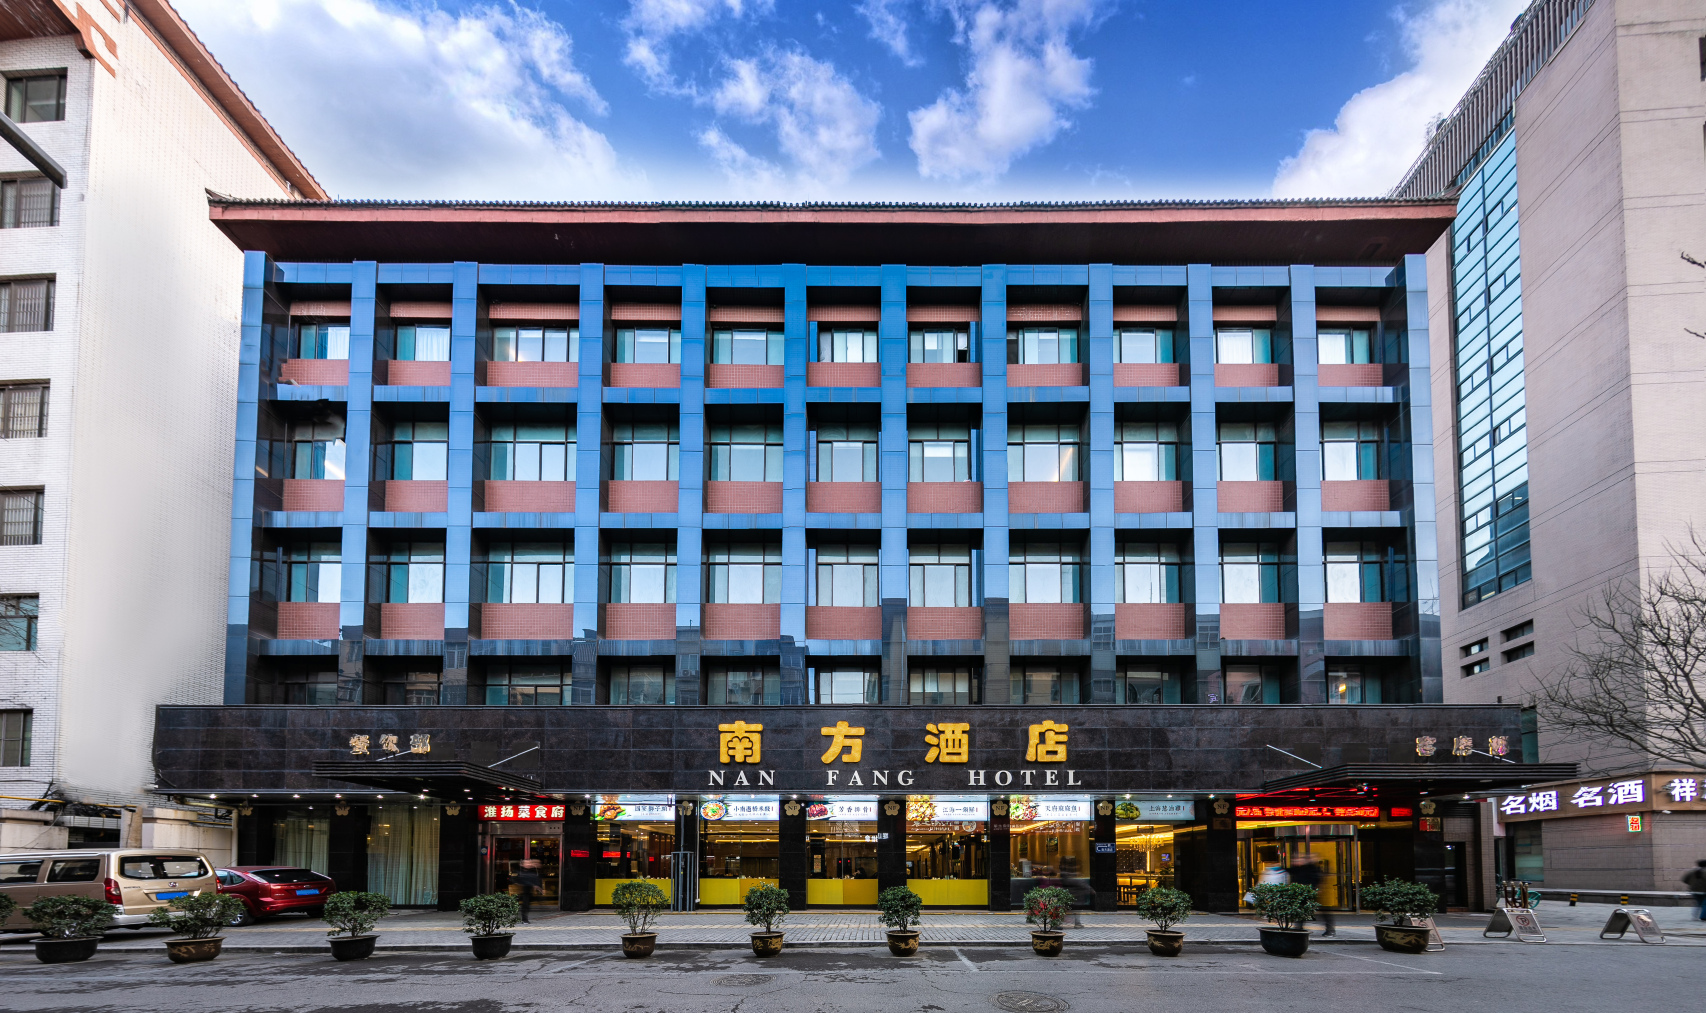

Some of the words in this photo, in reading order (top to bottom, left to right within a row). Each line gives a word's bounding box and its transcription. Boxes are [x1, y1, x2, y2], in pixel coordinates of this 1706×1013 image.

[718, 720, 1069, 764] 南方酒店
[708, 770, 776, 786] NAN
[826, 770, 915, 786] FANG
[968, 770, 1082, 786] HOTEL
[1500, 790, 1559, 815] 名烟
[1570, 779, 1645, 808] 名酒
[484, 805, 564, 818] 淮扬菜食府
